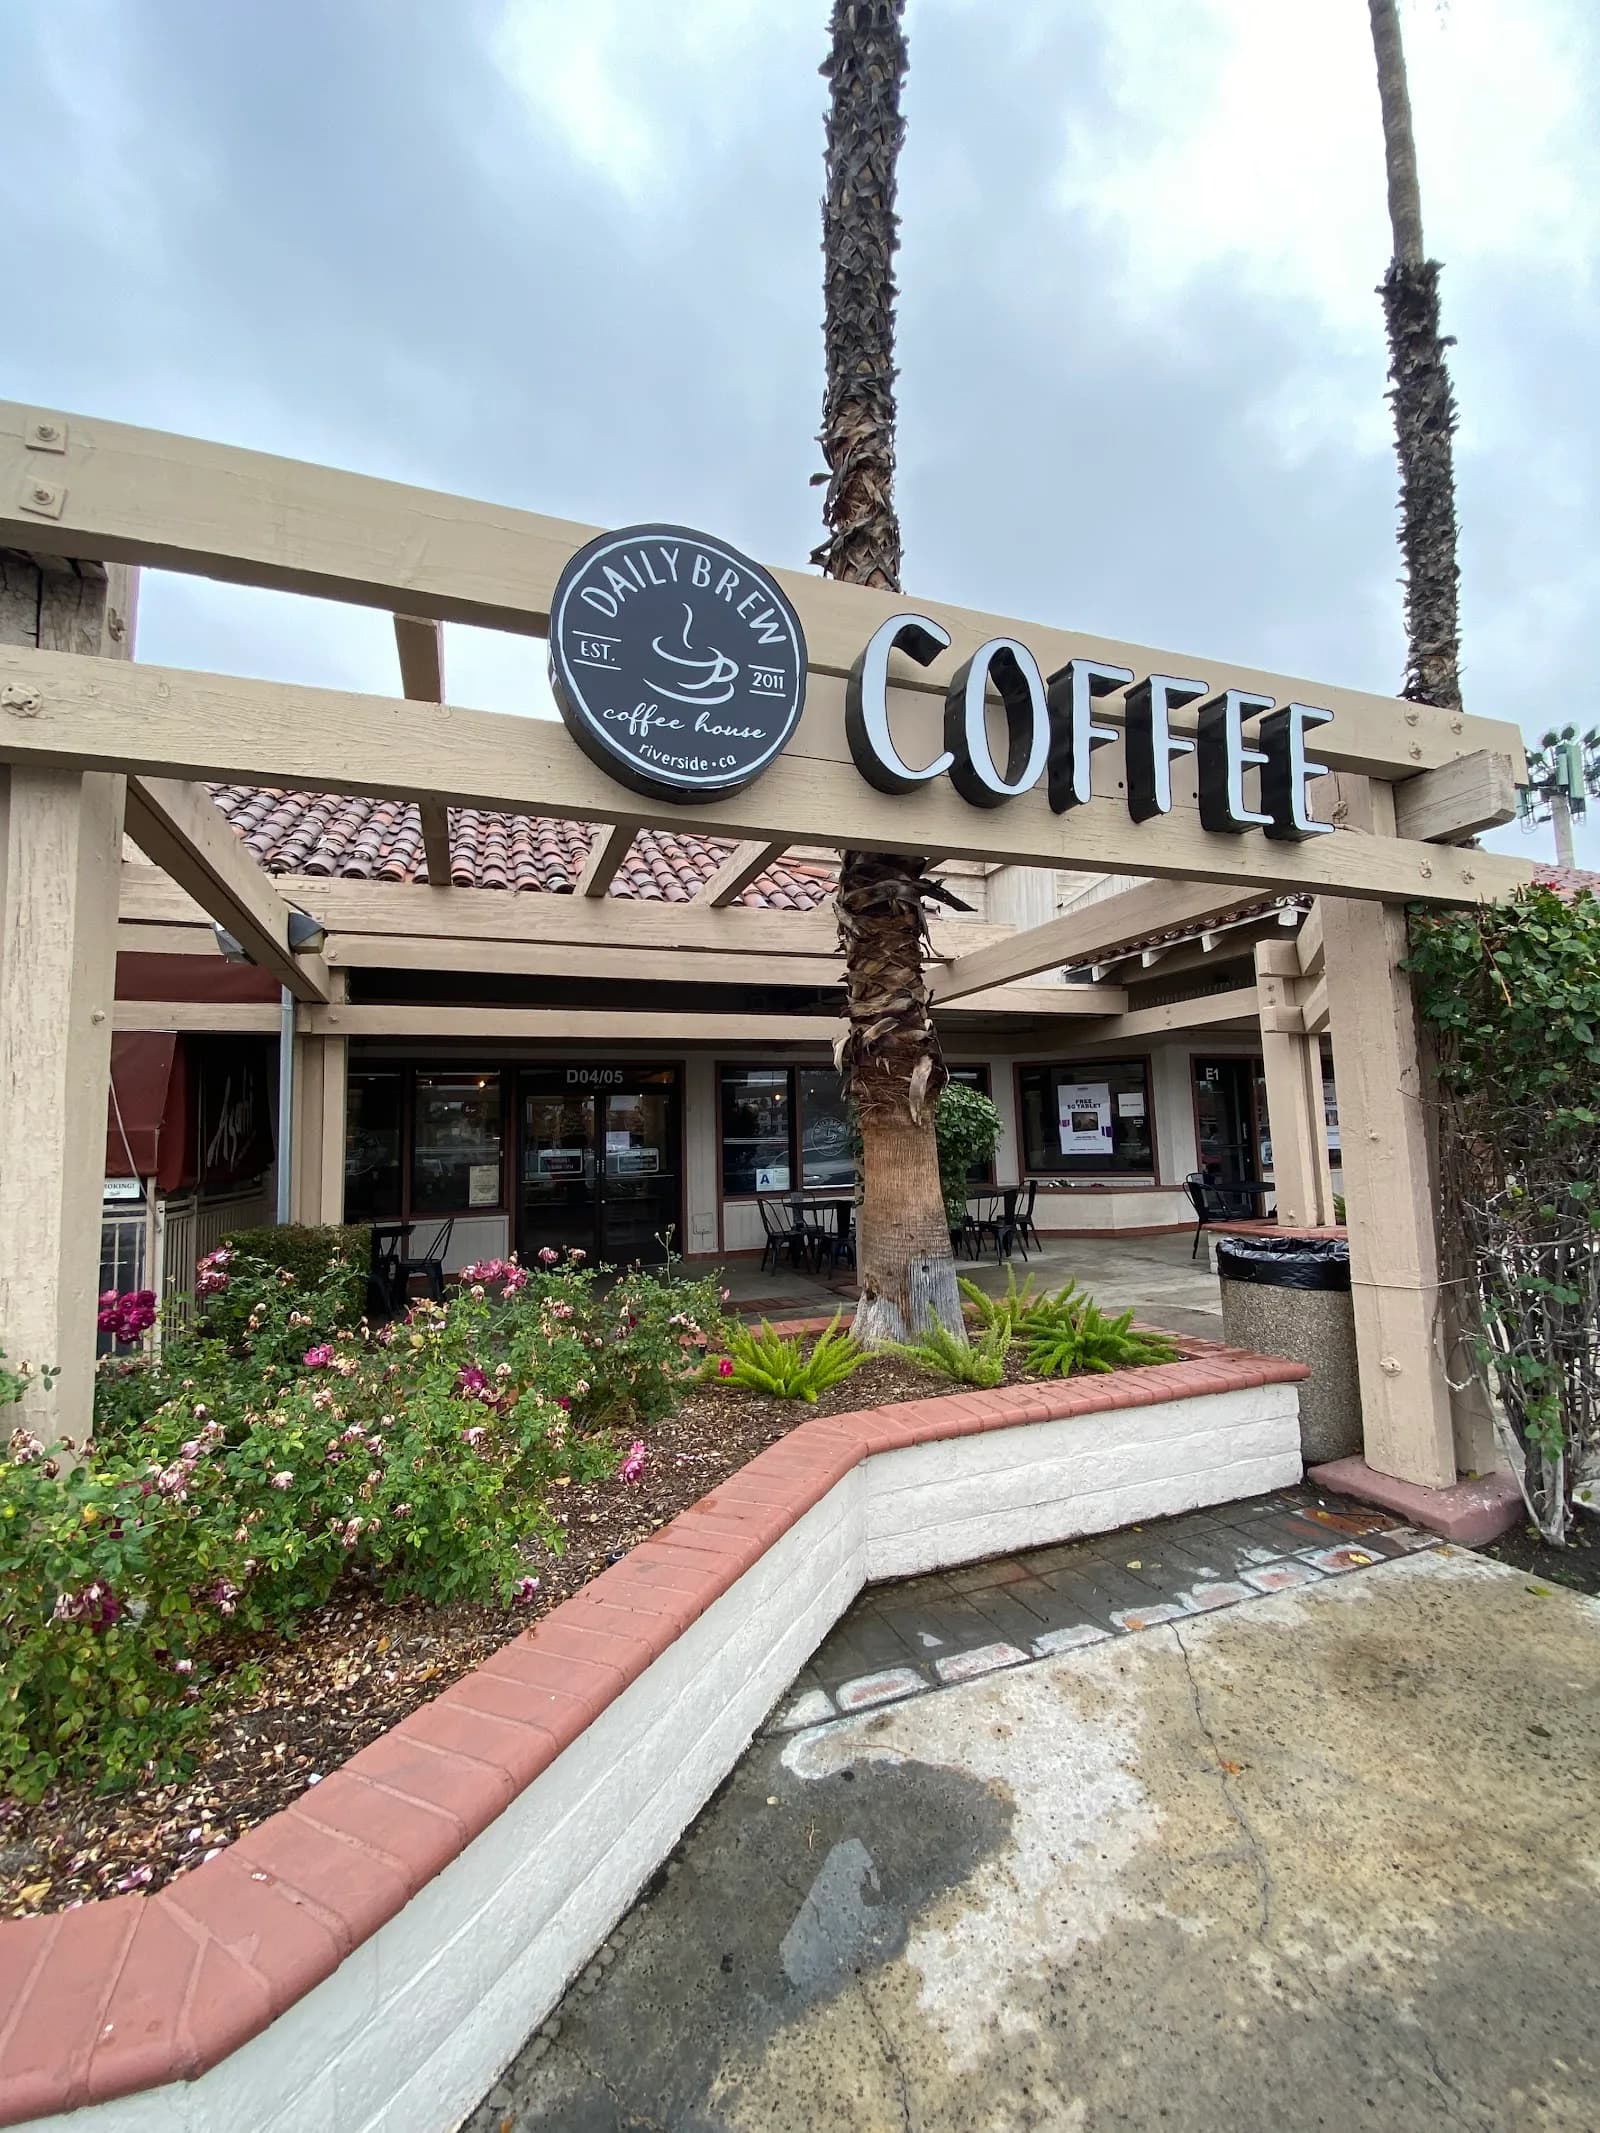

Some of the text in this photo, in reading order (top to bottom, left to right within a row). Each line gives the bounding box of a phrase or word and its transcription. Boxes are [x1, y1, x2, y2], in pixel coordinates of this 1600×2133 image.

[581, 547, 786, 644] DAILY BREW
[580, 640, 615, 661] EST.
[753, 672, 784, 690] 2011
[602, 702, 766, 739] coffee house
[848, 613, 1335, 838] COFFEE
[566, 1069, 623, 1083] D04/05
[1205, 1068, 1219, 1080] E1
[760, 1174, 770, 1184] A
